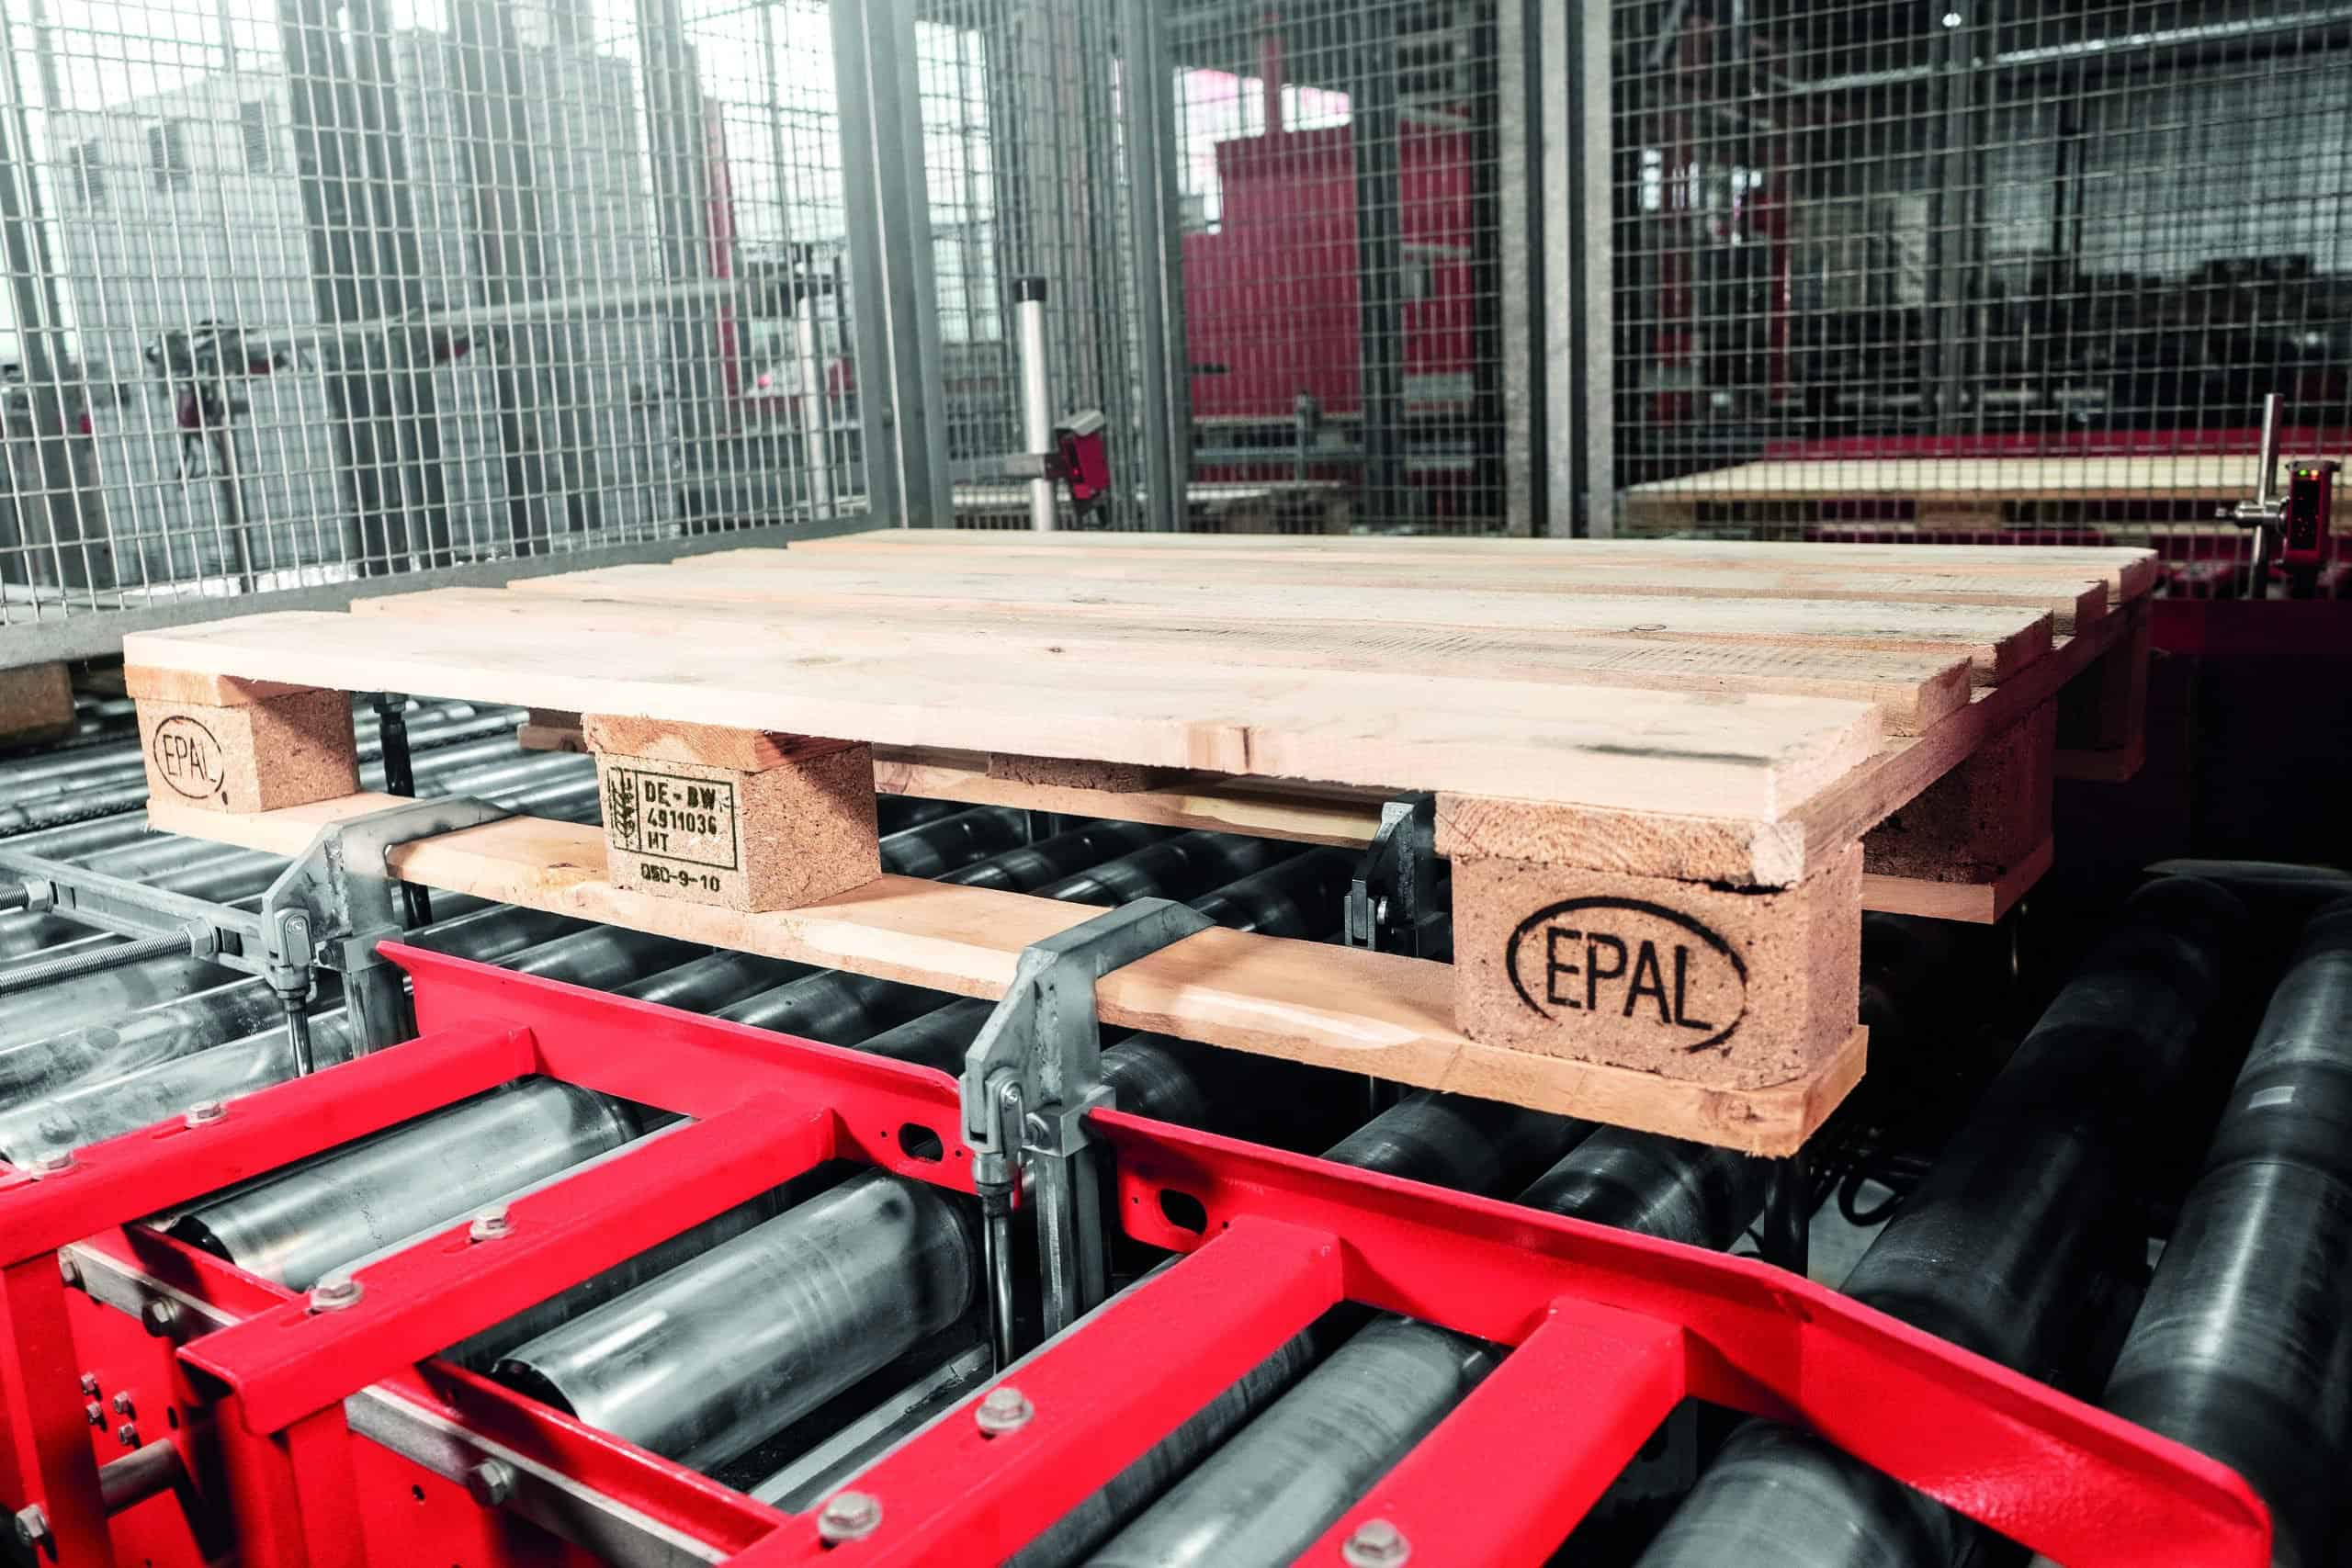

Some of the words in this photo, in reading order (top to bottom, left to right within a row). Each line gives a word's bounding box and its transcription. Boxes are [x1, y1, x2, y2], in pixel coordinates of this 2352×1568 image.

[163, 734, 217, 784] EPAL
[647, 807, 717, 835] 4911036
[647, 830, 669, 852] HT
[1546, 926, 1713, 1032] EPAL
